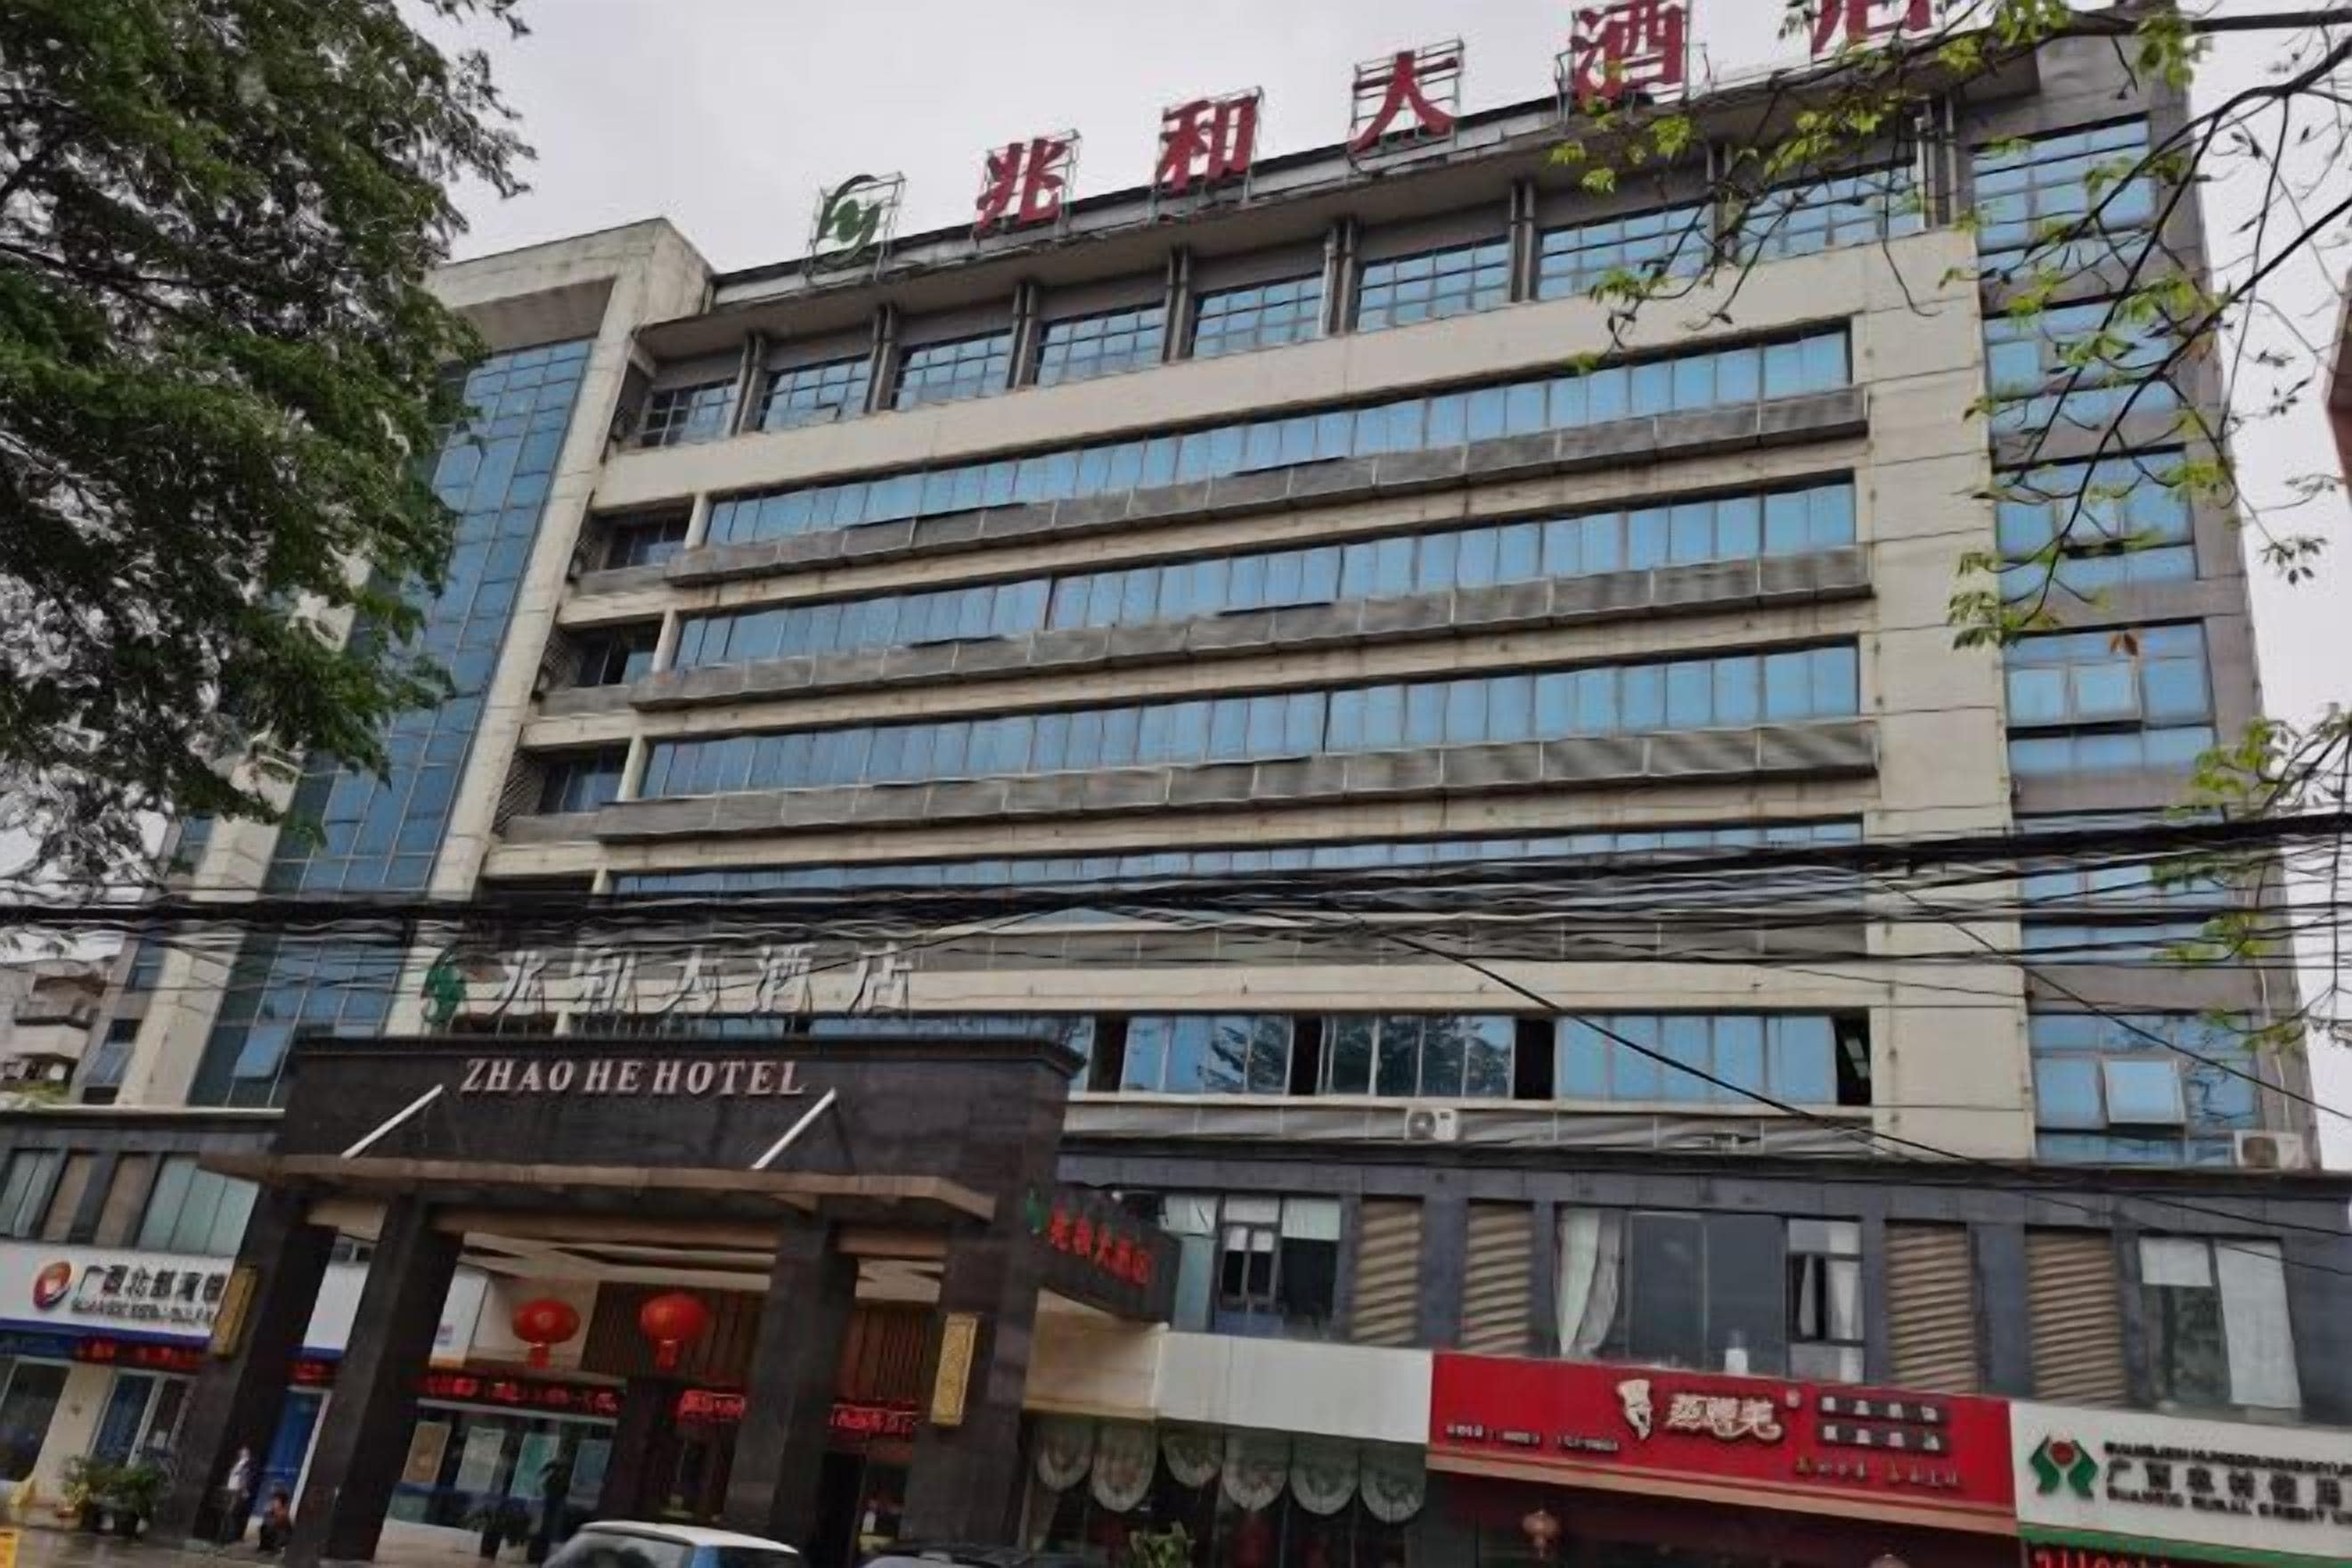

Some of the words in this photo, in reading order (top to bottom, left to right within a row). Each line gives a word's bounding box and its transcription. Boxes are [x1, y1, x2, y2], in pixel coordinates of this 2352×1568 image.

[461, 1058, 574, 1092] ZHAO
[584, 1060, 641, 1093] HE
[652, 1060, 805, 1097] HOTEL
